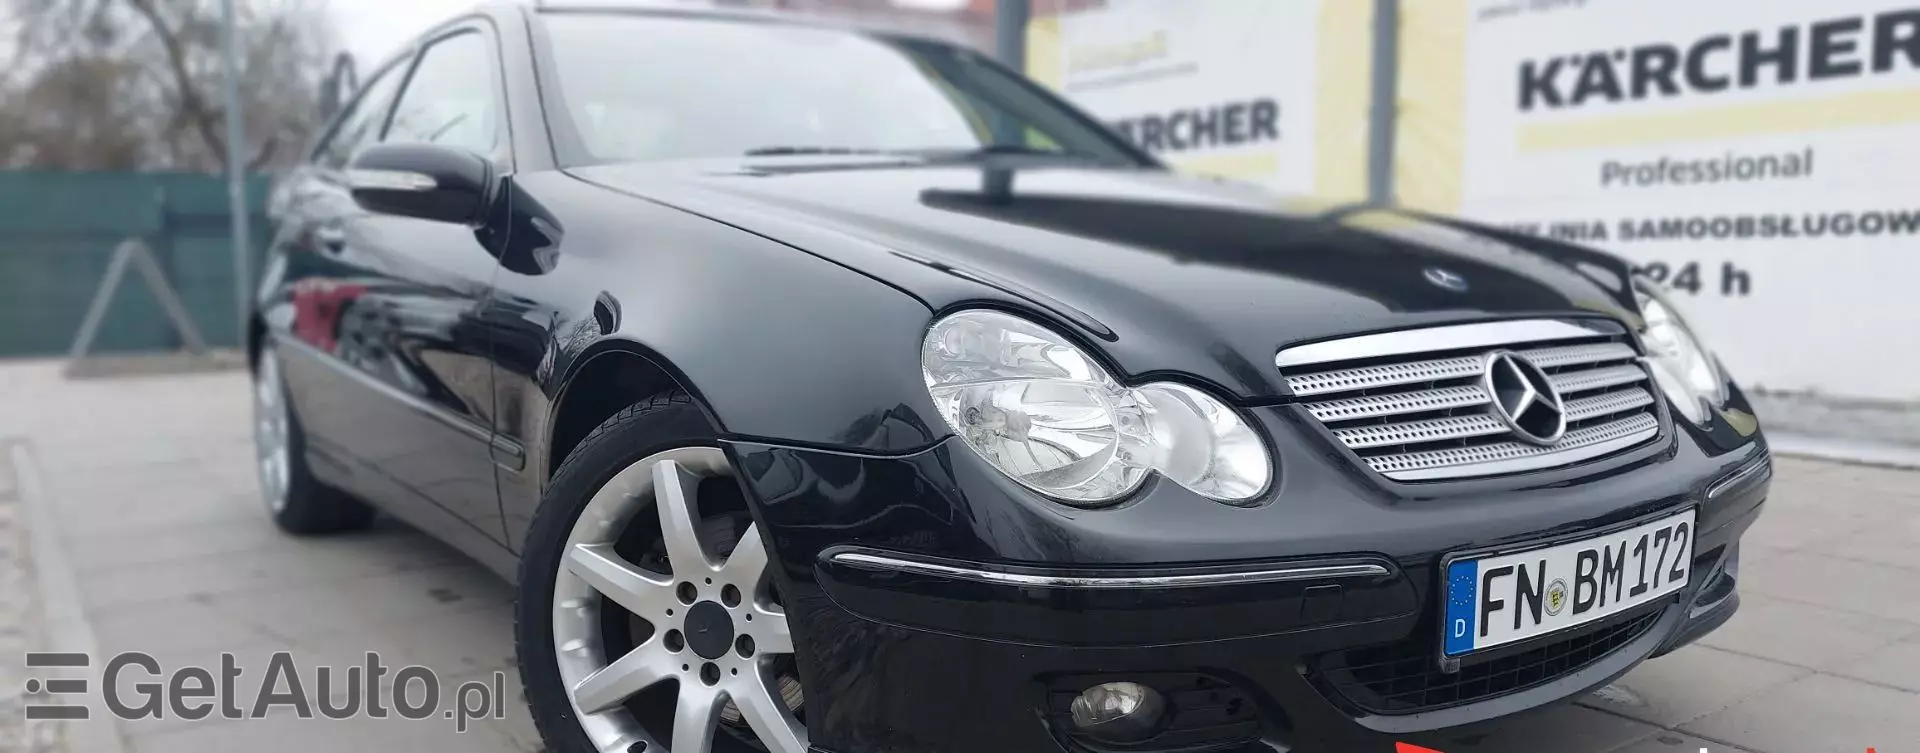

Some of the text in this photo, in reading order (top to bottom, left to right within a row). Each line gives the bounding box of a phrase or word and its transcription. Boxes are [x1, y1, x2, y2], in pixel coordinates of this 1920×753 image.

[1517, 9, 1920, 111] KÄRCHER
[1104, 98, 1280, 152] RCHER
[1600, 147, 1815, 187] Professional
[1643, 260, 1752, 297] 24 h
[1479, 559, 1547, 638] FN
[1454, 618, 1466, 639] D
